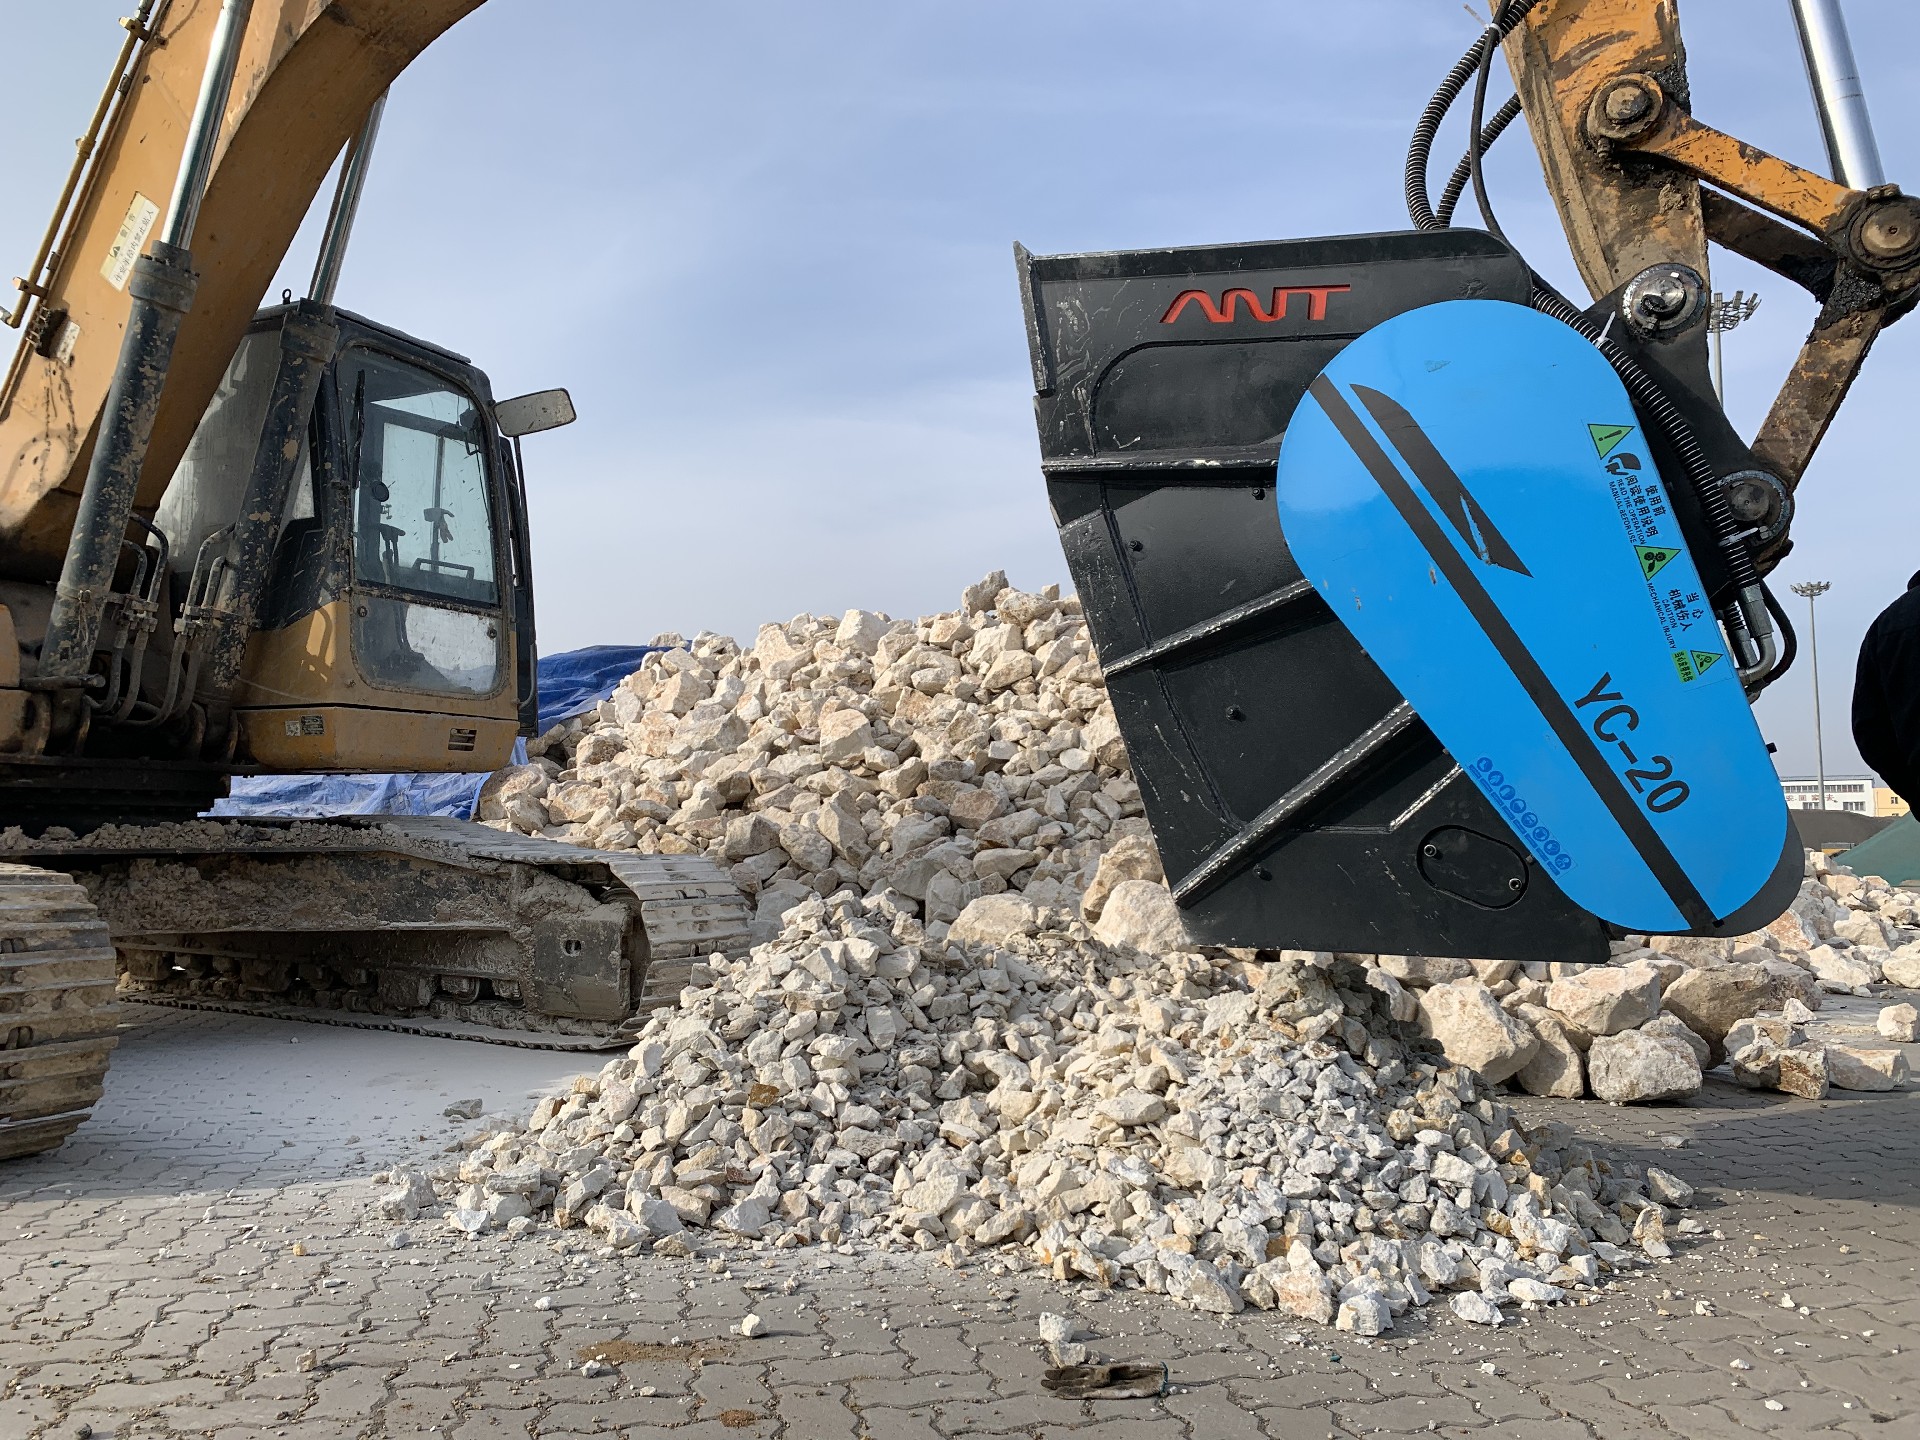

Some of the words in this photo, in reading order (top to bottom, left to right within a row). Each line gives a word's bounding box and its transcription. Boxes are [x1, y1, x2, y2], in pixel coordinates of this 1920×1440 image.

[1160, 284, 1351, 323] ANT
[1609, 481, 1623, 509] MANUAL
[1617, 479, 1627, 496] READ
[1623, 496, 1632, 509] THE
[1629, 509, 1647, 544] OPERATION
[1625, 475, 1659, 537] 阅读使用说明
[1645, 485, 1666, 516] 使用前
[1647, 582, 1667, 624] MECHANICAL
[1663, 626, 1676, 649] INJURY
[1662, 599, 1677, 629] CAUTION
[1668, 588, 1693, 631] 机械伤人
[1686, 592, 1704, 619] 当心
[1574, 672, 1690, 813] YC-20
